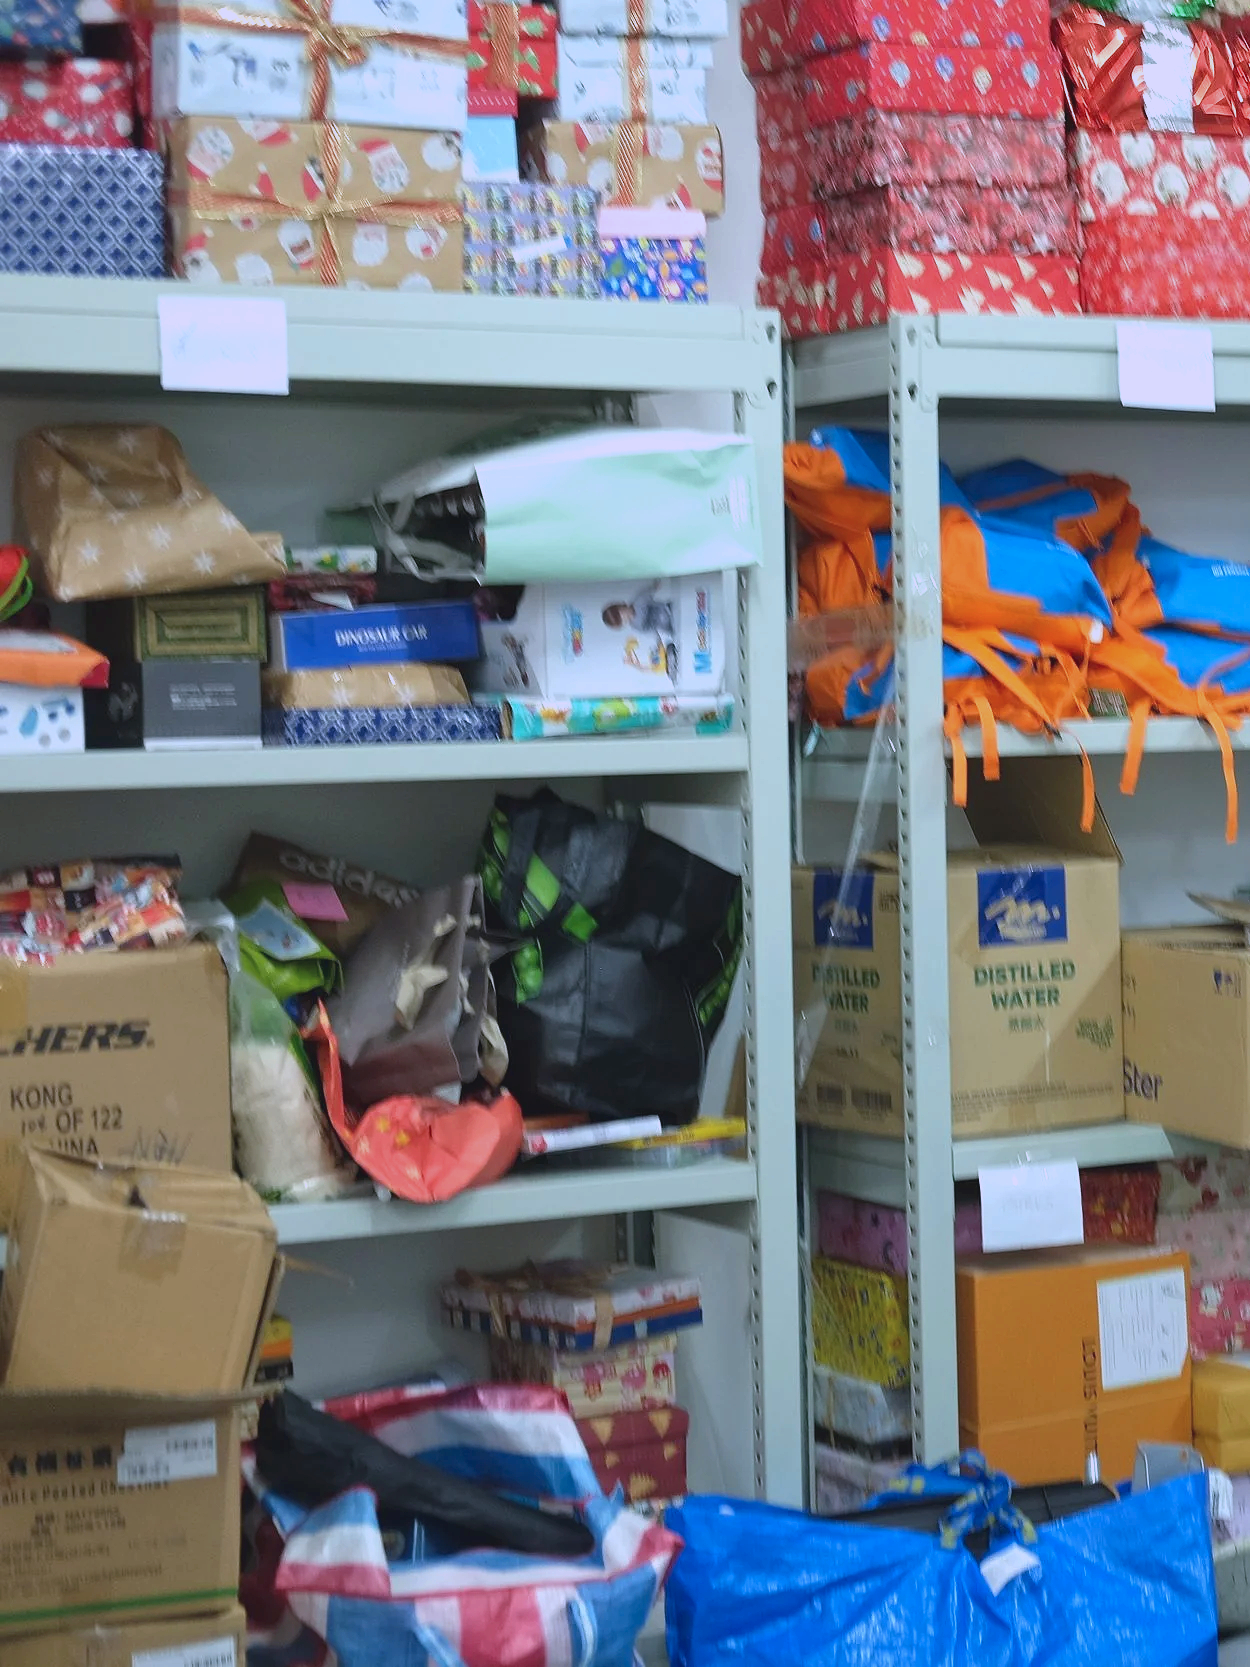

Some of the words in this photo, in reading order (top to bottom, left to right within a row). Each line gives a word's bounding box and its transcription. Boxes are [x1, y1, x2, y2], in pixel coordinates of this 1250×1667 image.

[974, 958, 1076, 987] DISTILLED
[991, 984, 1060, 1011] WATER
[10, 1081, 73, 1110] KONG
[55, 1106, 84, 1134] OF
[91, 1101, 123, 1131] 122
